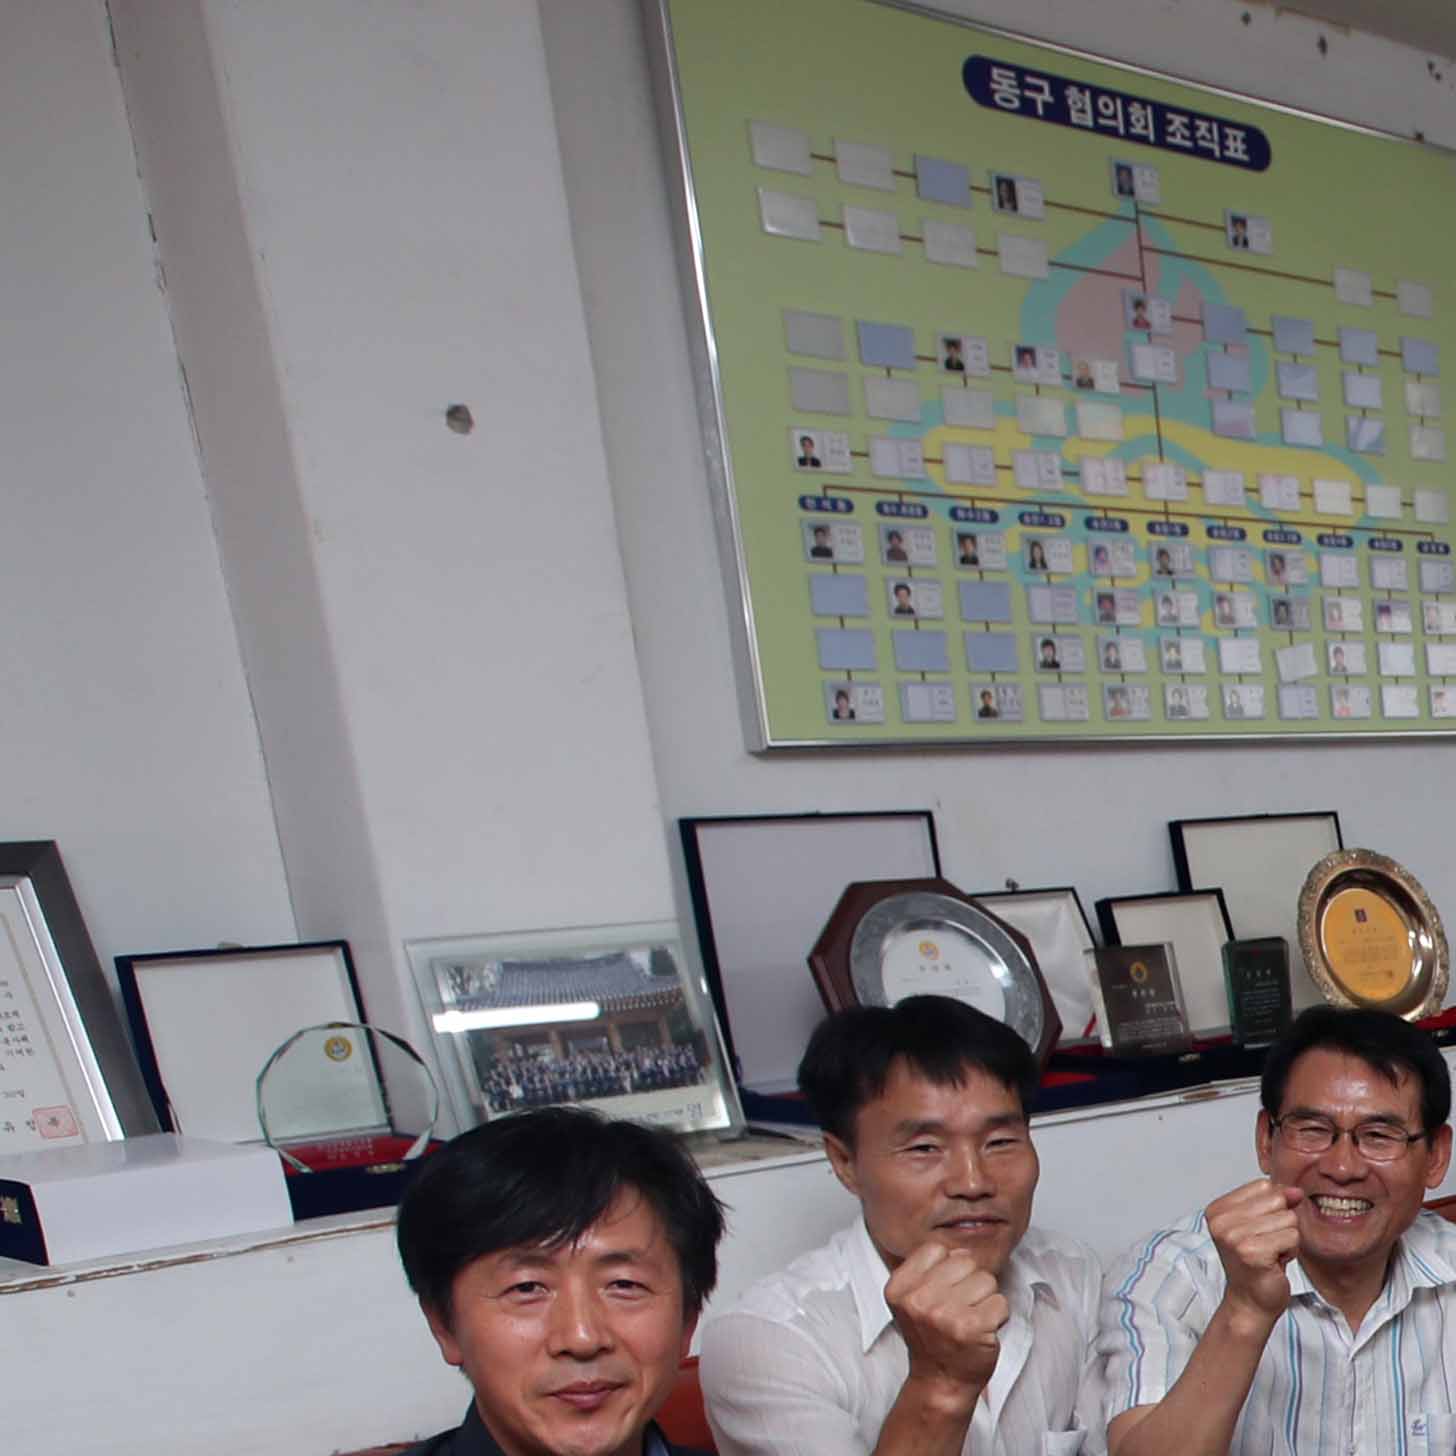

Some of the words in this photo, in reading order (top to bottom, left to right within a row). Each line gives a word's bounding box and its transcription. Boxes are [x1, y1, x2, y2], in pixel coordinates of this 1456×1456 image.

[989, 66, 1054, 116] 동구
[1064, 85, 1155, 142] 협의회
[1165, 112, 1249, 161] 조직표
